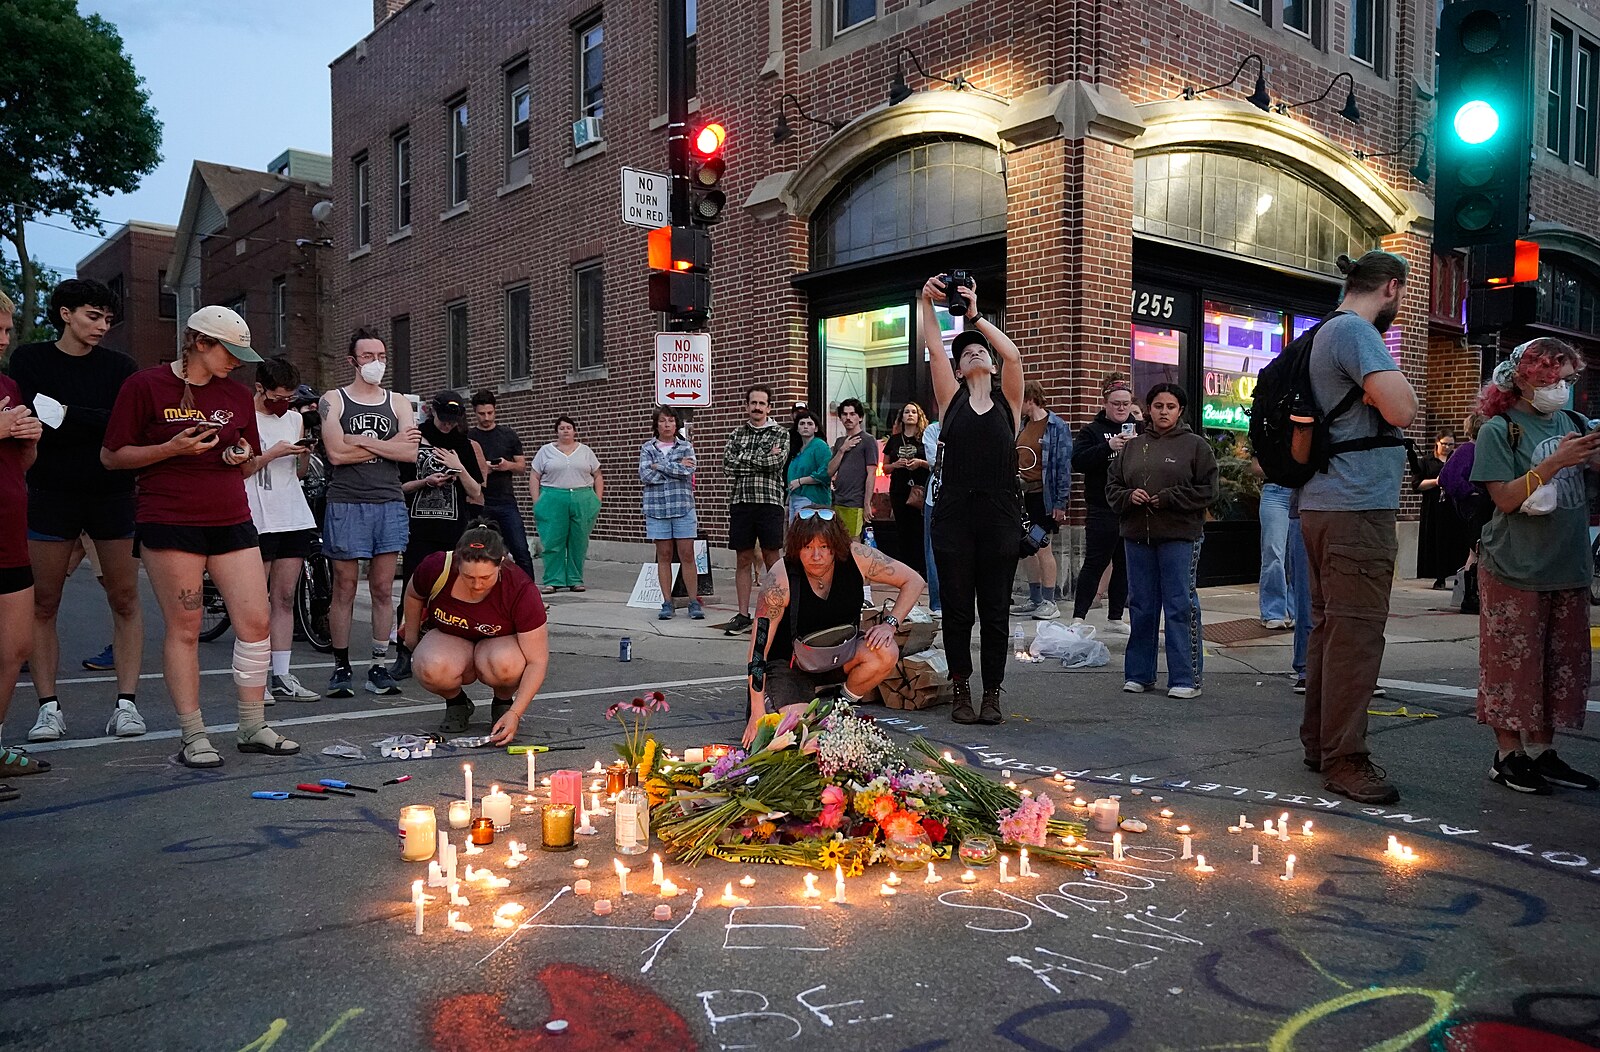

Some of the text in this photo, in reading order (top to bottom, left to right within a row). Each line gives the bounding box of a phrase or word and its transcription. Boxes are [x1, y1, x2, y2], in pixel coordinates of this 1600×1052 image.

[638, 176, 653, 191] NO
[635, 192, 658, 206] TURN
[629, 206, 664, 222] ON RED
[1131, 289, 1175, 319] 1255
[675, 339, 691, 351] NO
[662, 352, 704, 362] STOPPING
[662, 363, 704, 373] STANDING
[664, 378, 702, 388] PARKING
[1205, 371, 1259, 400] CHA CH
[164, 408, 207, 421] MUFA
[352, 414, 389, 433] NETS
[434, 607, 469, 628] MUFA
